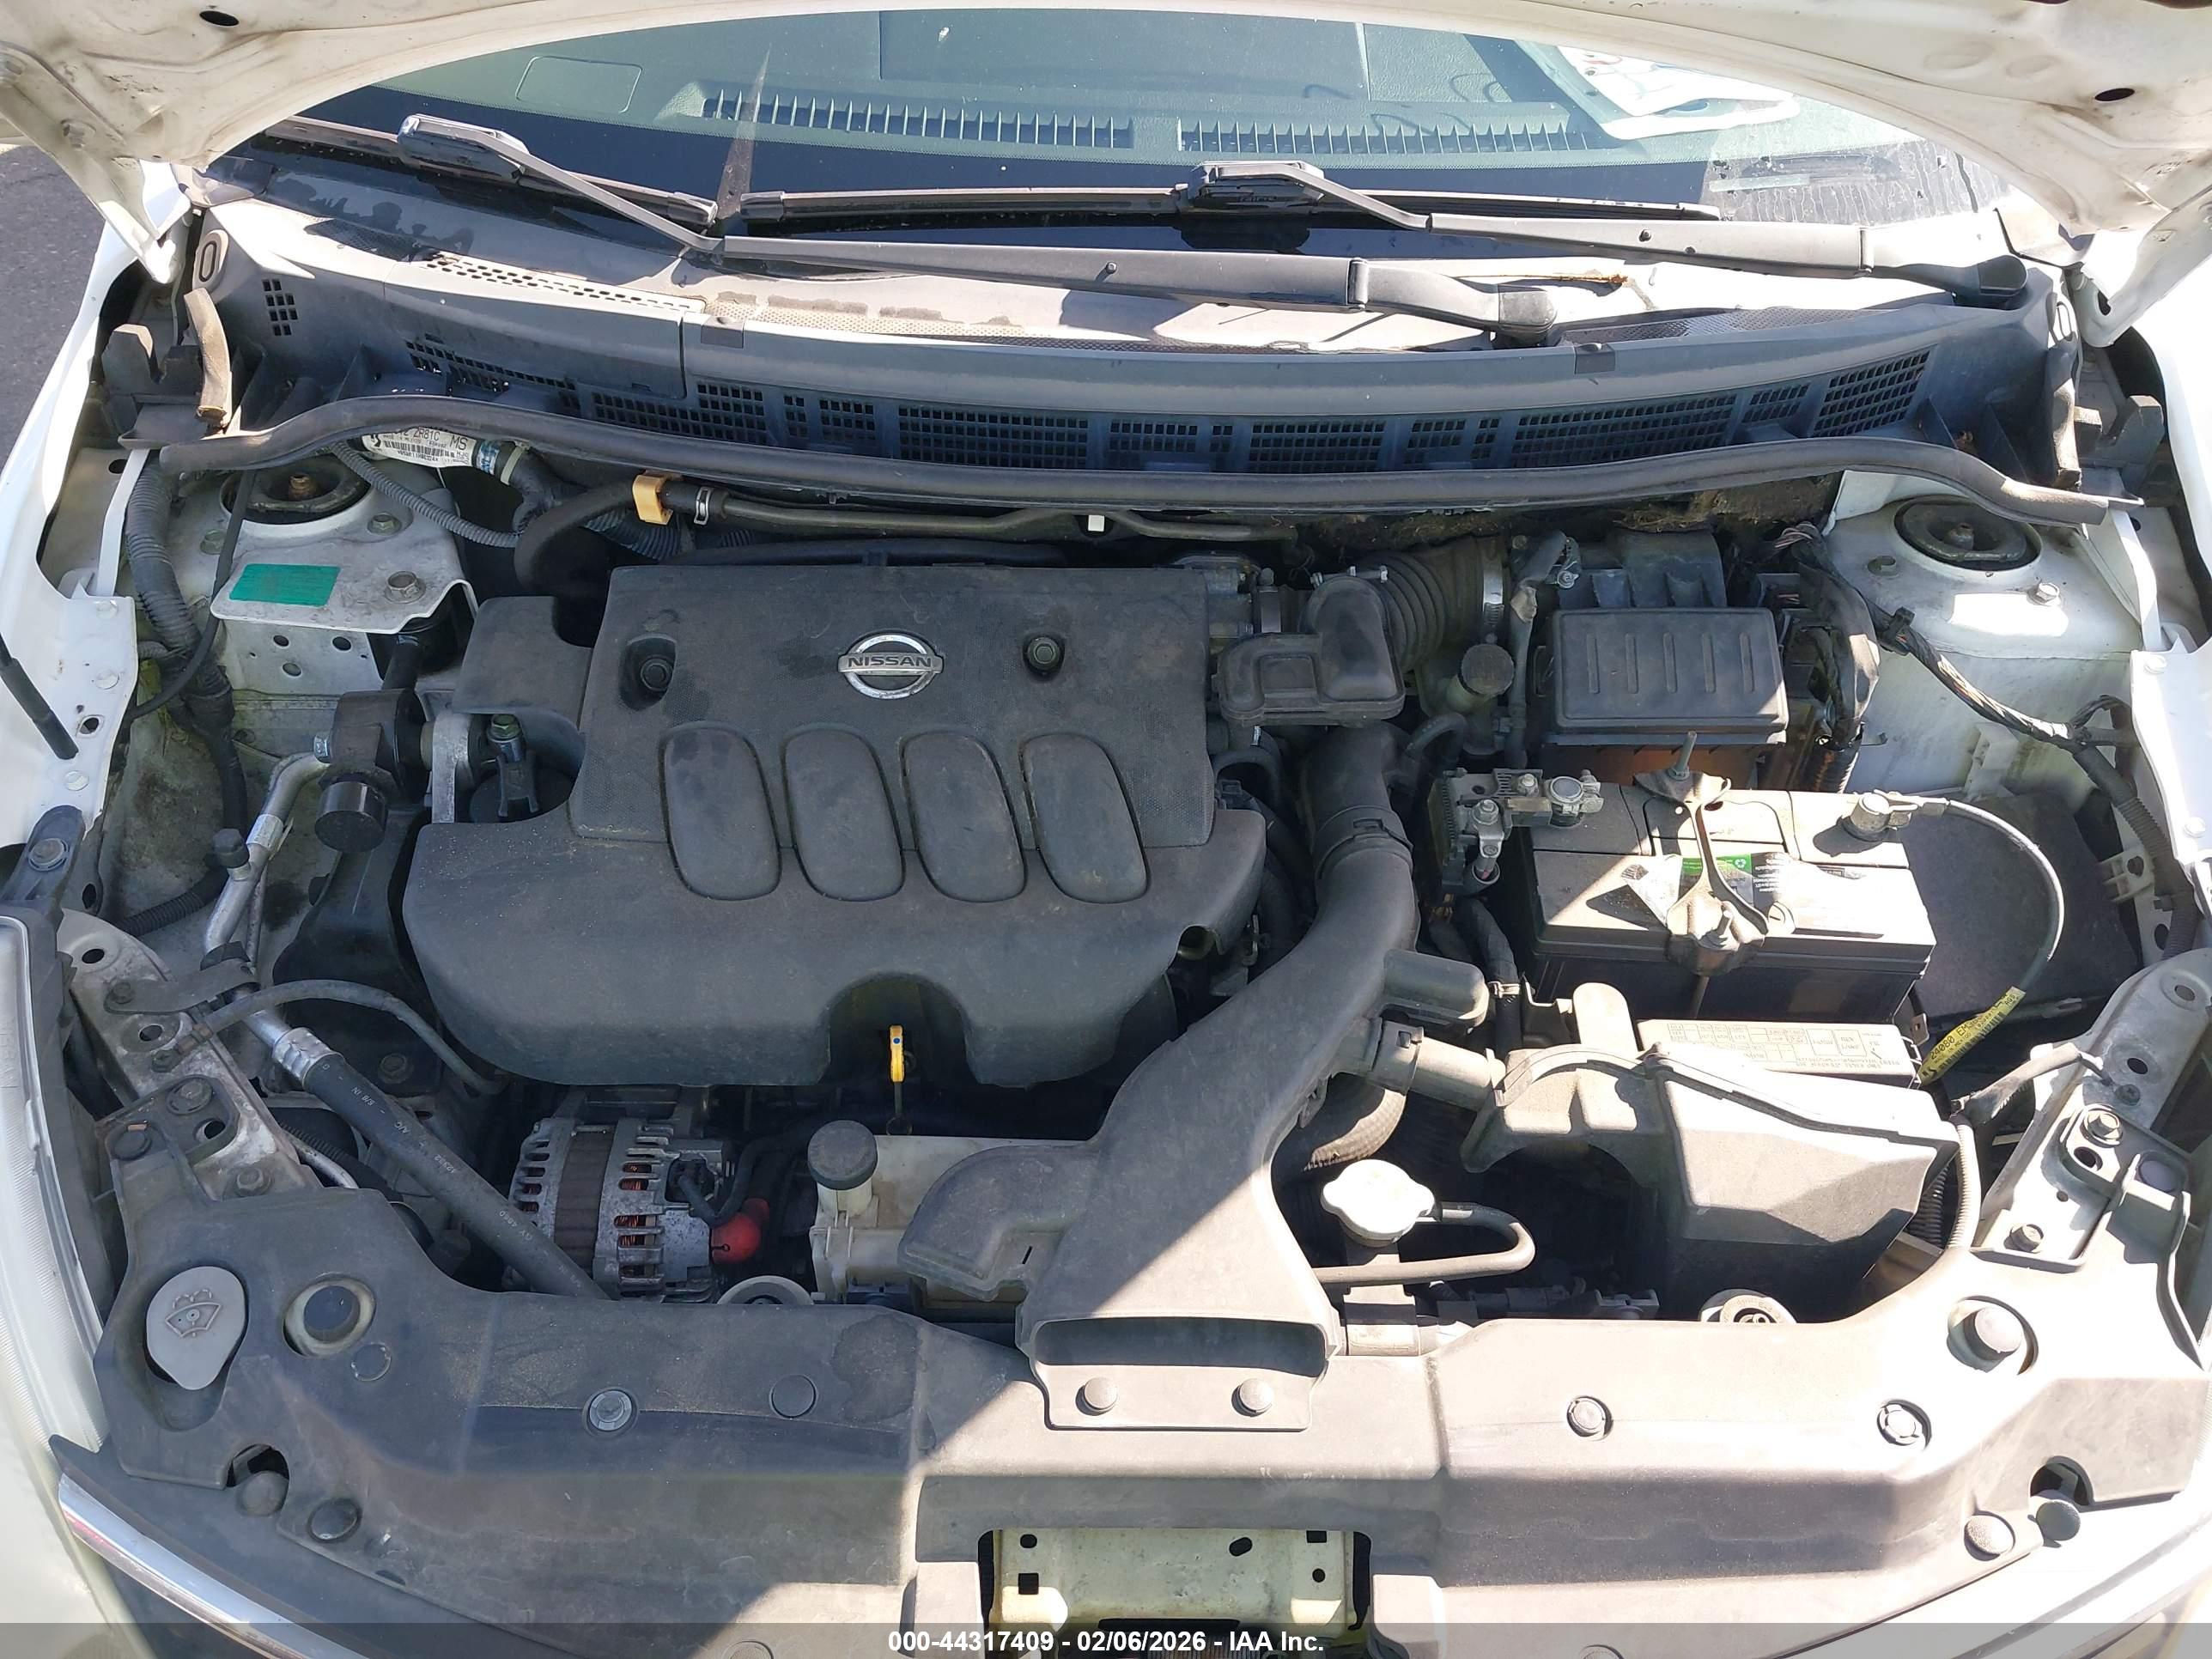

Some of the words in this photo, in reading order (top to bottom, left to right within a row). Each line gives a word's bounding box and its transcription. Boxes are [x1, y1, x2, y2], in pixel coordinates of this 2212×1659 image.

[449, 435, 468, 451] MS
[848, 656, 932, 667] NISSAN
[1929, 1036, 1955, 1060] 24080
[350, 1086, 362, 1096] IN
[394, 1119, 410, 1133] A/C
